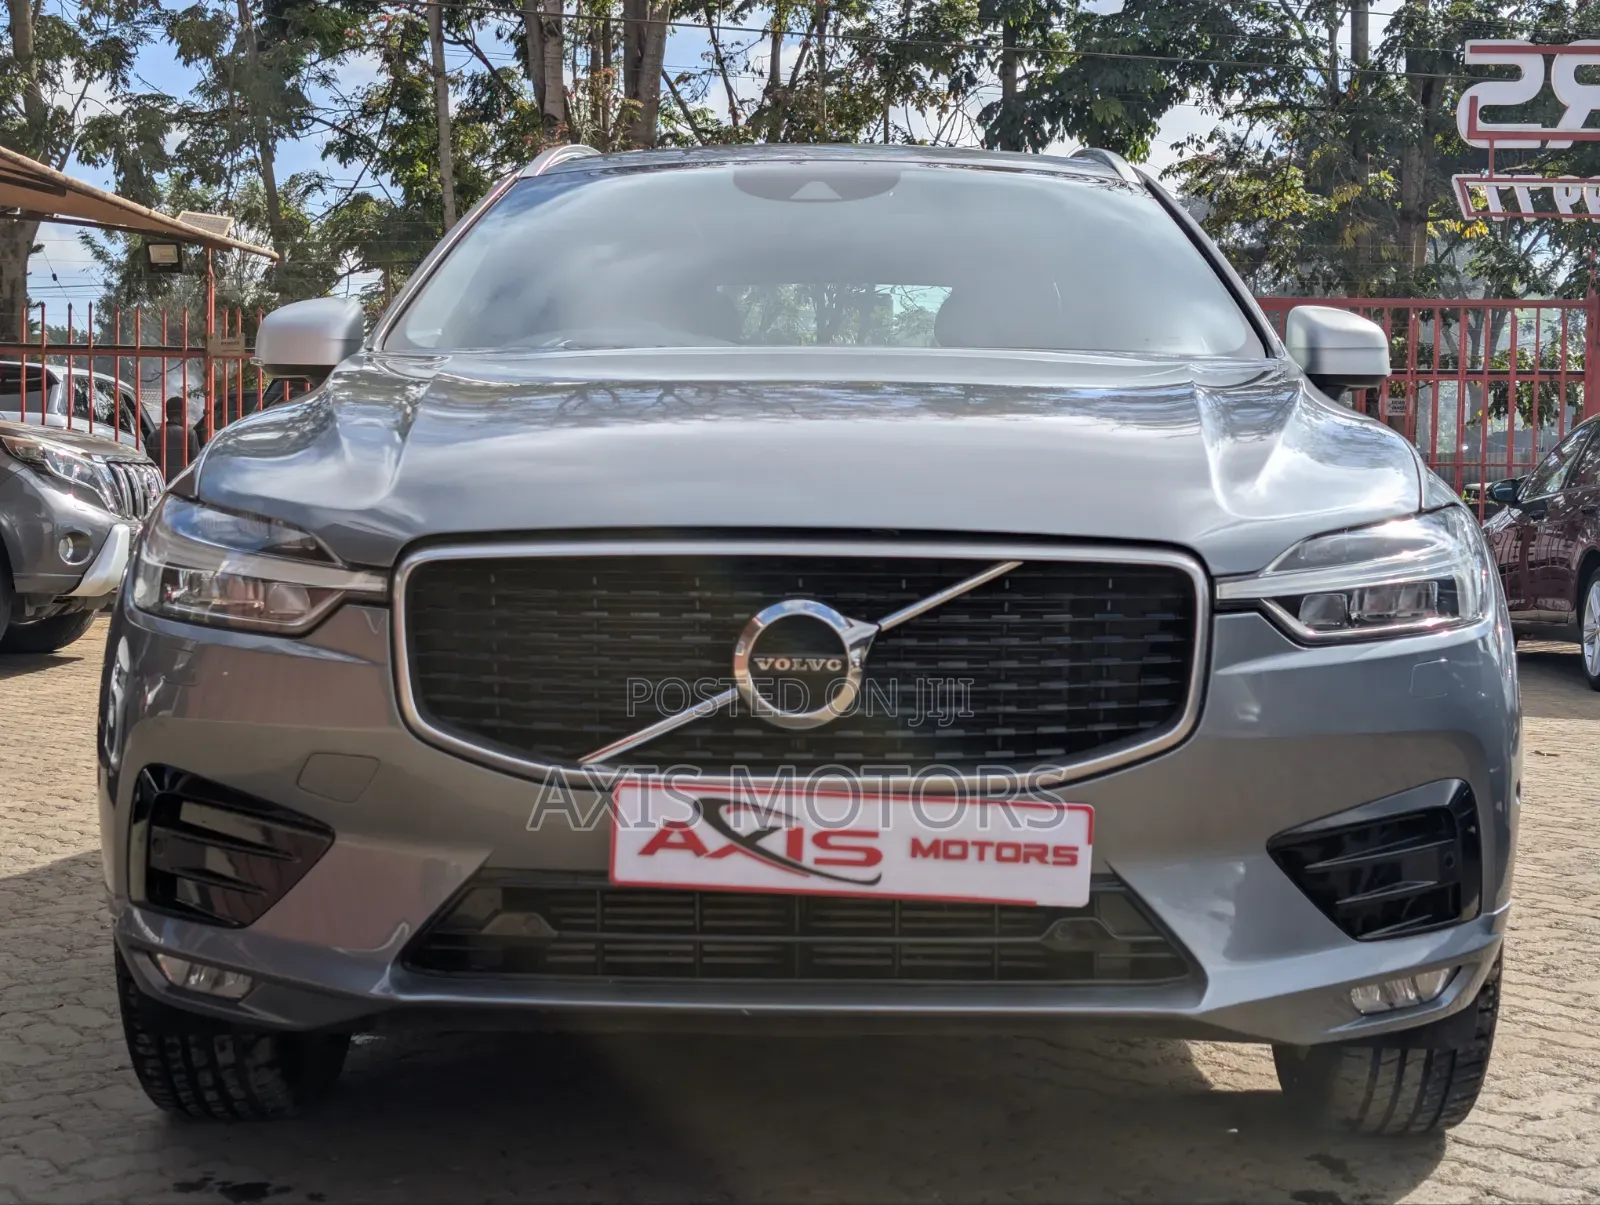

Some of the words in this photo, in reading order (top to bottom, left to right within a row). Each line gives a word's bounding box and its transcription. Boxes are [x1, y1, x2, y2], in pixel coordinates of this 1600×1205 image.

[753, 657, 842, 671] VOLVO
[638, 806, 884, 880] AXIS
[910, 837, 1080, 867] MOTORS
